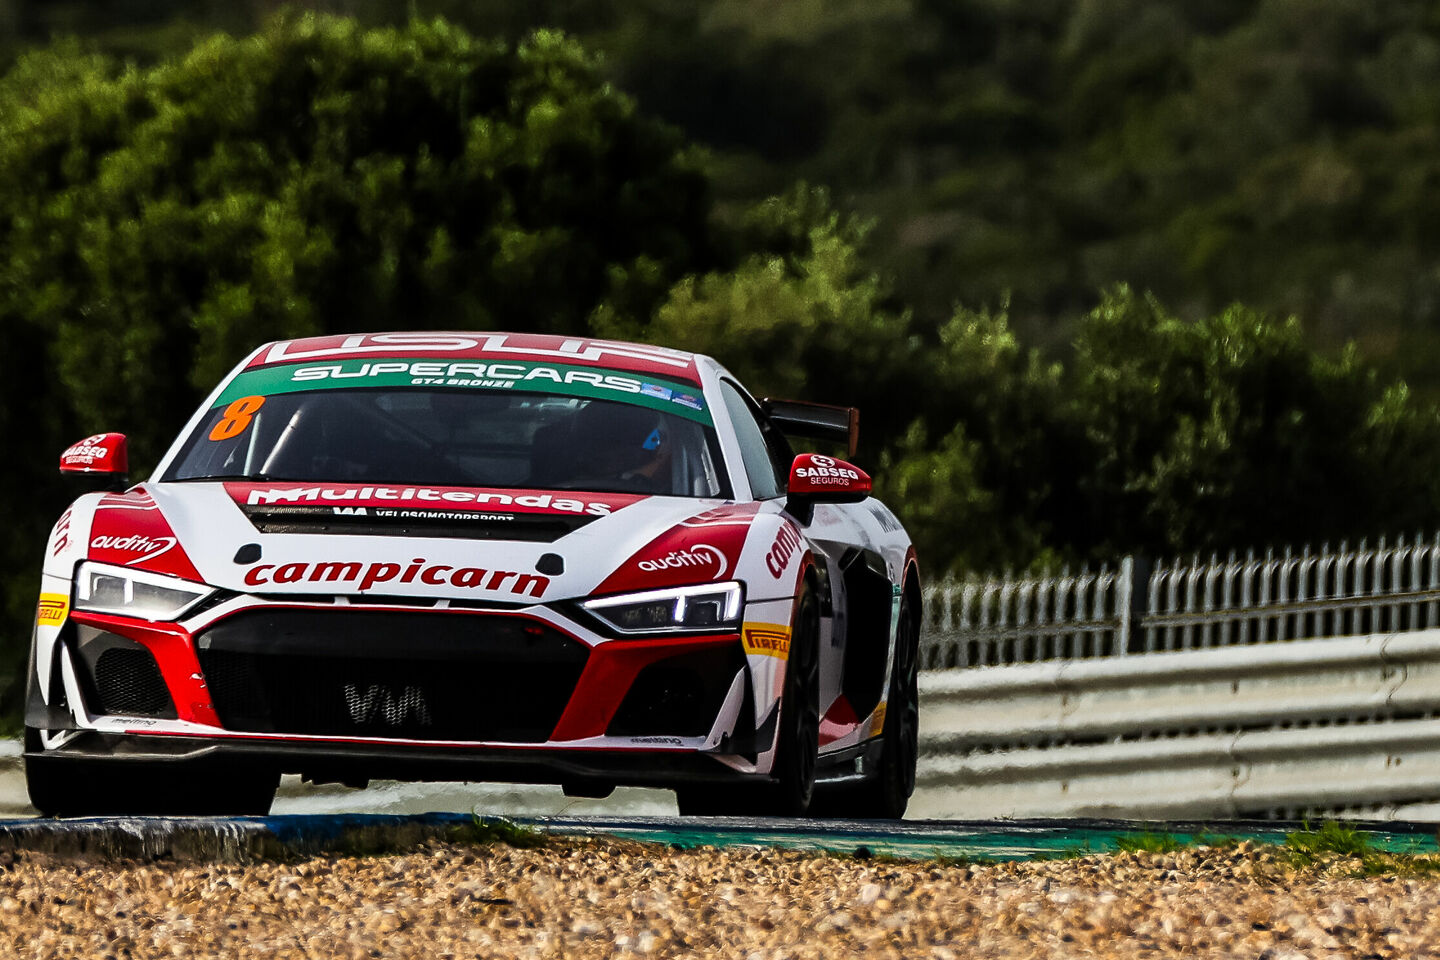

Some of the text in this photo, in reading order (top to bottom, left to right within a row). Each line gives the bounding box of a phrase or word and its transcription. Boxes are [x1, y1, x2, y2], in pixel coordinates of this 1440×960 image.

[291, 361, 642, 394] SUPERCARS
[410, 378, 515, 389] GT4 BRONZE
[208, 395, 266, 442] 8
[795, 467, 859, 480] SABSEG
[810, 477, 850, 486] SEGUROS
[244, 558, 551, 598] campicarn
